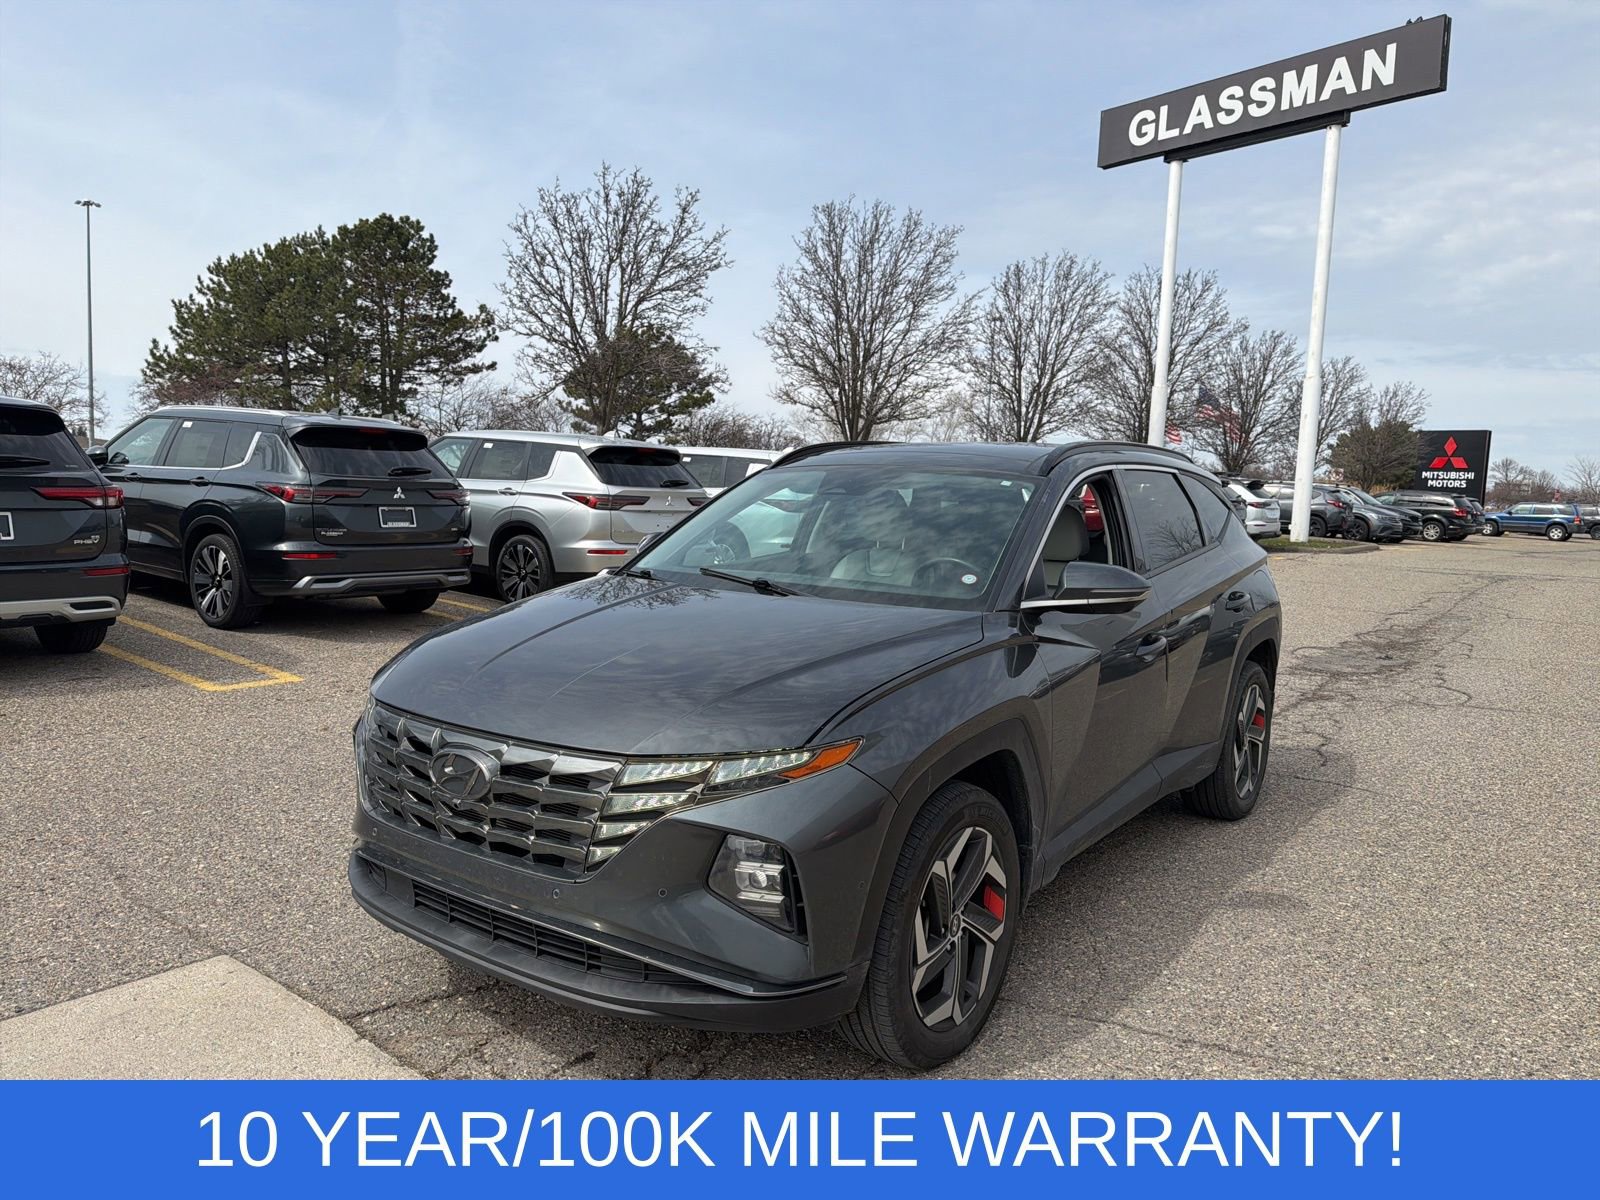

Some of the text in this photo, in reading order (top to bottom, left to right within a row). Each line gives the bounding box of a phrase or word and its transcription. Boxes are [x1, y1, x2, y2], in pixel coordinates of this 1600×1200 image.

[1127, 42, 1398, 147] GLASSMAN
[1421, 471, 1475, 480] MITSUBISHI
[1427, 480, 1467, 488] MOTORS
